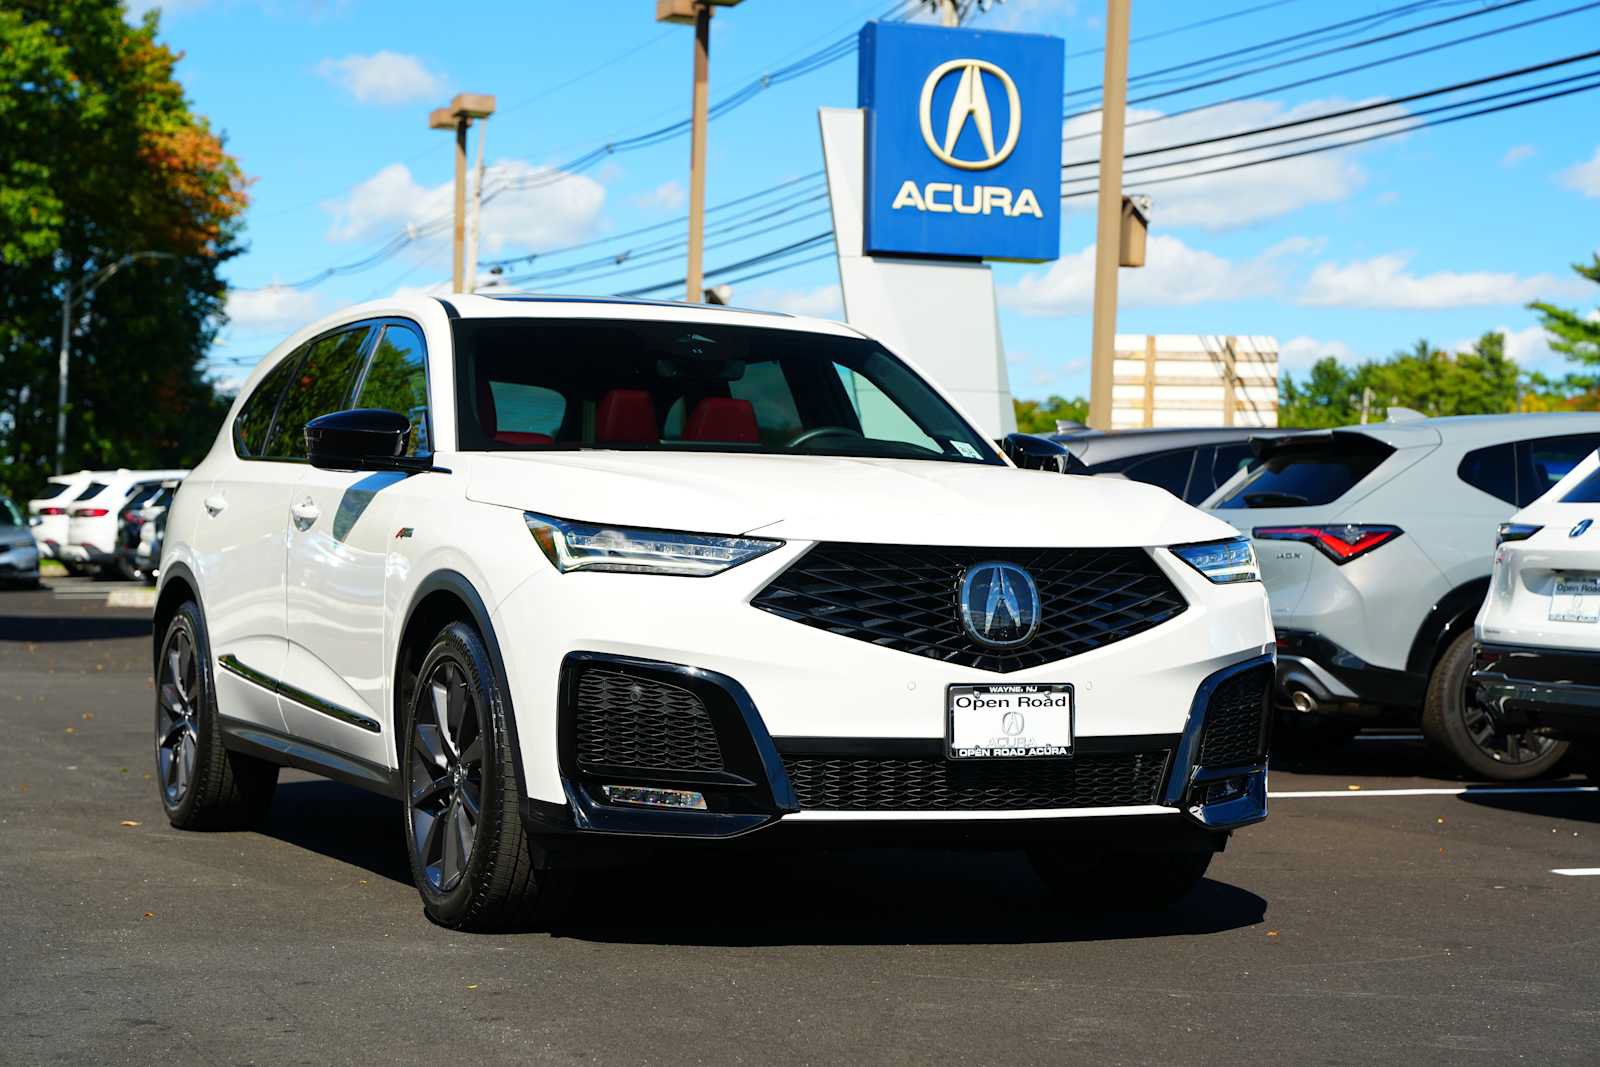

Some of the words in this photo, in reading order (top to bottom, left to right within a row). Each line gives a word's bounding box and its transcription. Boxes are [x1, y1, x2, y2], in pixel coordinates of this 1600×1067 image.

[892, 180, 1043, 219] ACURA
[1557, 583, 1579, 592] Open
[956, 697, 1010, 711] Open
[1018, 696, 1066, 708] Road
[959, 748, 991, 757] OPEN
[993, 748, 1026, 757] ROAD
[1027, 747, 1067, 757] ACURA
